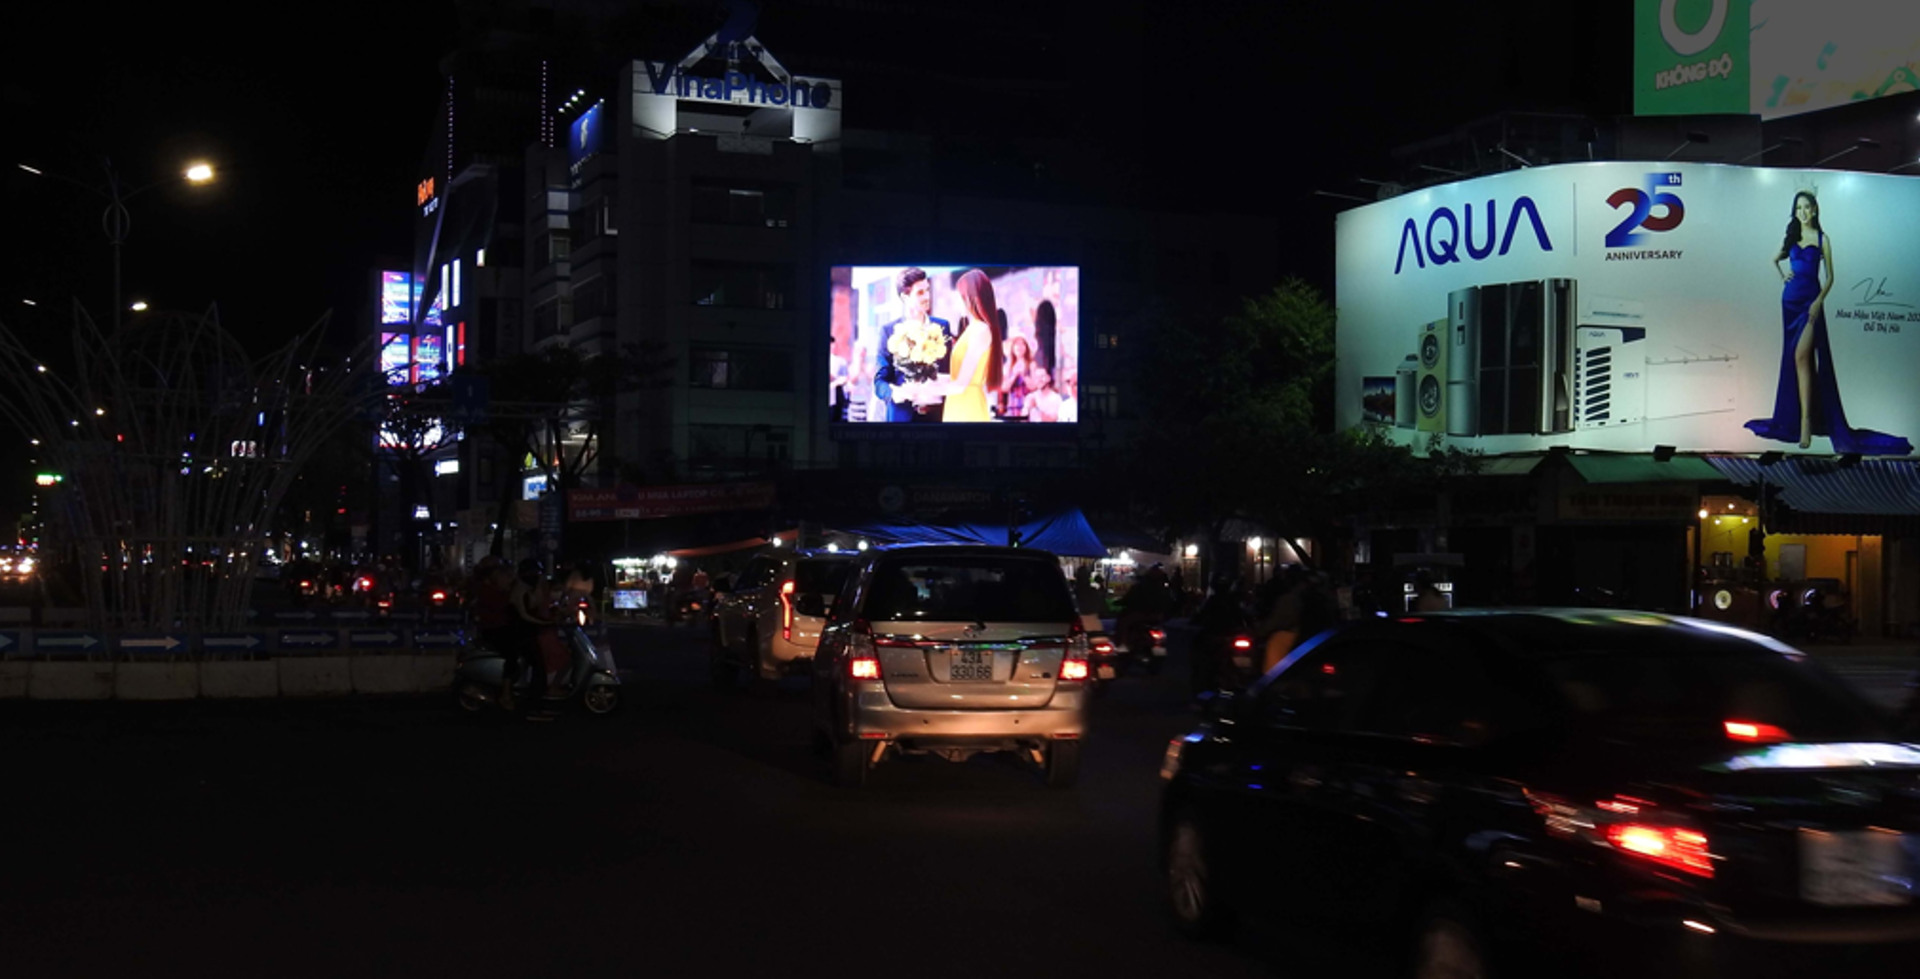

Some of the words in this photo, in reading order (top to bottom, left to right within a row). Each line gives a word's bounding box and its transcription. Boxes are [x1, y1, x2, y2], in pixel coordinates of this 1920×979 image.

[1655, 63, 1707, 90] KHÔNG
[1708, 52, 1733, 80] ĐỘ
[644, 59, 831, 108] VinaPhone
[1394, 196, 1552, 274] AQUA
[1605, 250, 1683, 261] ANNIVERSARY
[1887, 312, 1905, 320] Nam
[671, 489, 708, 499] LAPTOP
[913, 491, 992, 503] DANAWATCH
